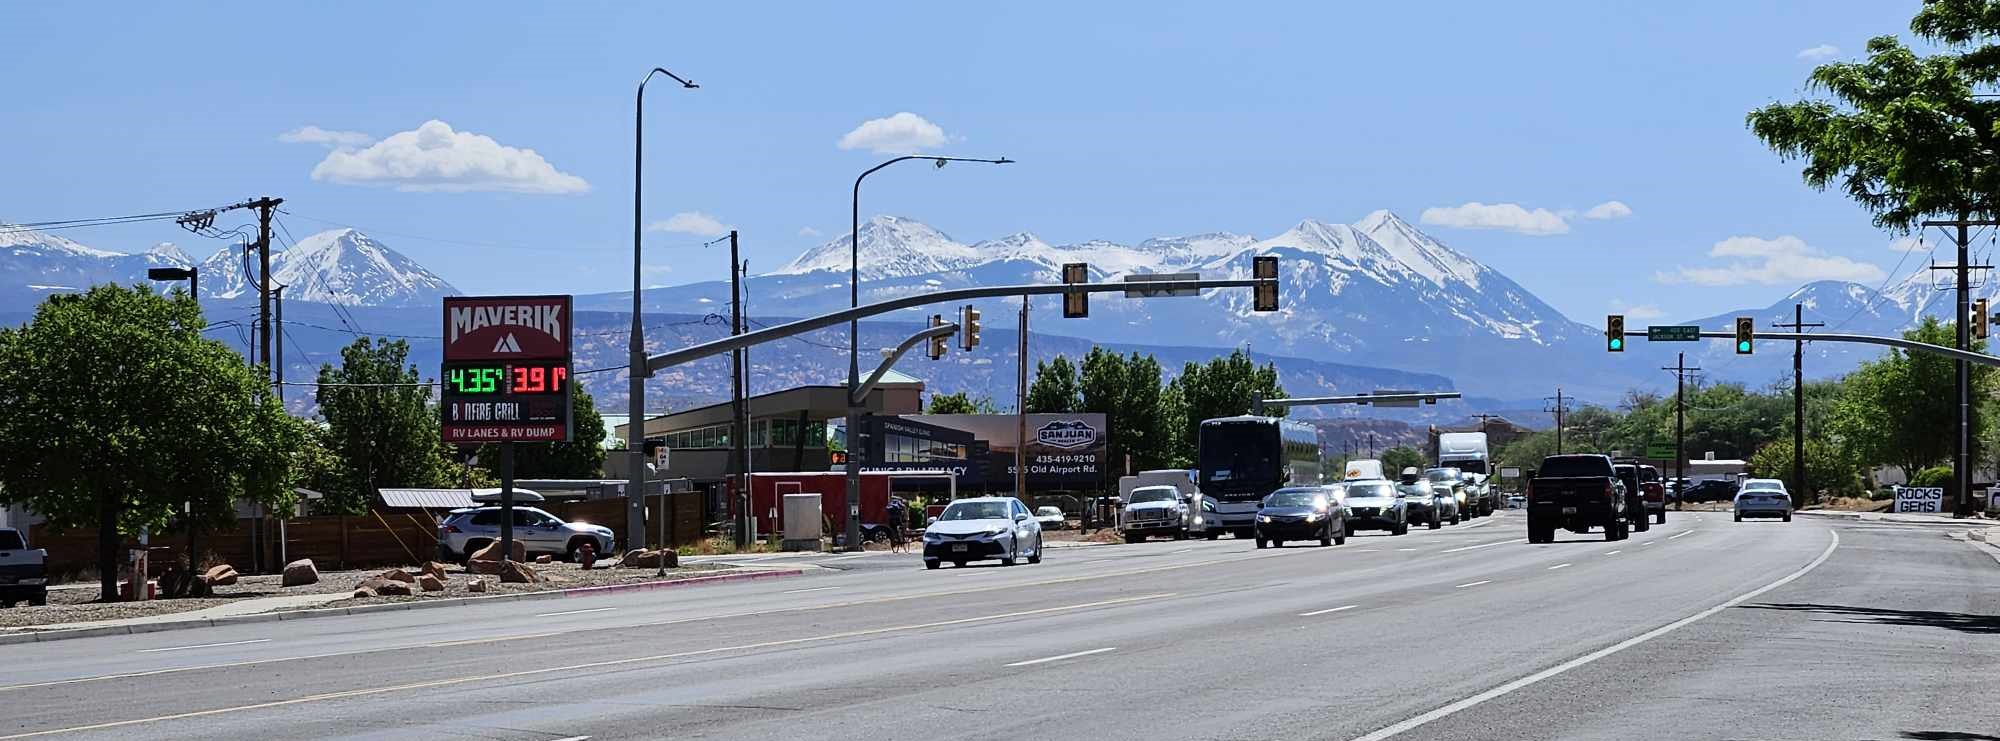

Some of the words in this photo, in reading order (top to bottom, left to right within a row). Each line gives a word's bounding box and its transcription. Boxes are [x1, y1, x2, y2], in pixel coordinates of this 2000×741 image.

[450, 305, 561, 344] MAVERIK
[494, 402, 520, 421] GRILL
[452, 428, 466, 438] RV
[467, 428, 499, 438] LANES
[501, 428, 508, 438] &
[511, 428, 524, 438] RV
[526, 427, 555, 438] DUMP
[1036, 454, 1095, 463] 435-419-9210
[1007, 466, 1029, 474] 555
[1031, 465, 1047, 473] Old
[1049, 465, 1080, 475] Airport
[1083, 464, 1098, 472] Rd.
[1897, 488, 1941, 500] ROCKS
[1901, 501, 1935, 512] GEMS
